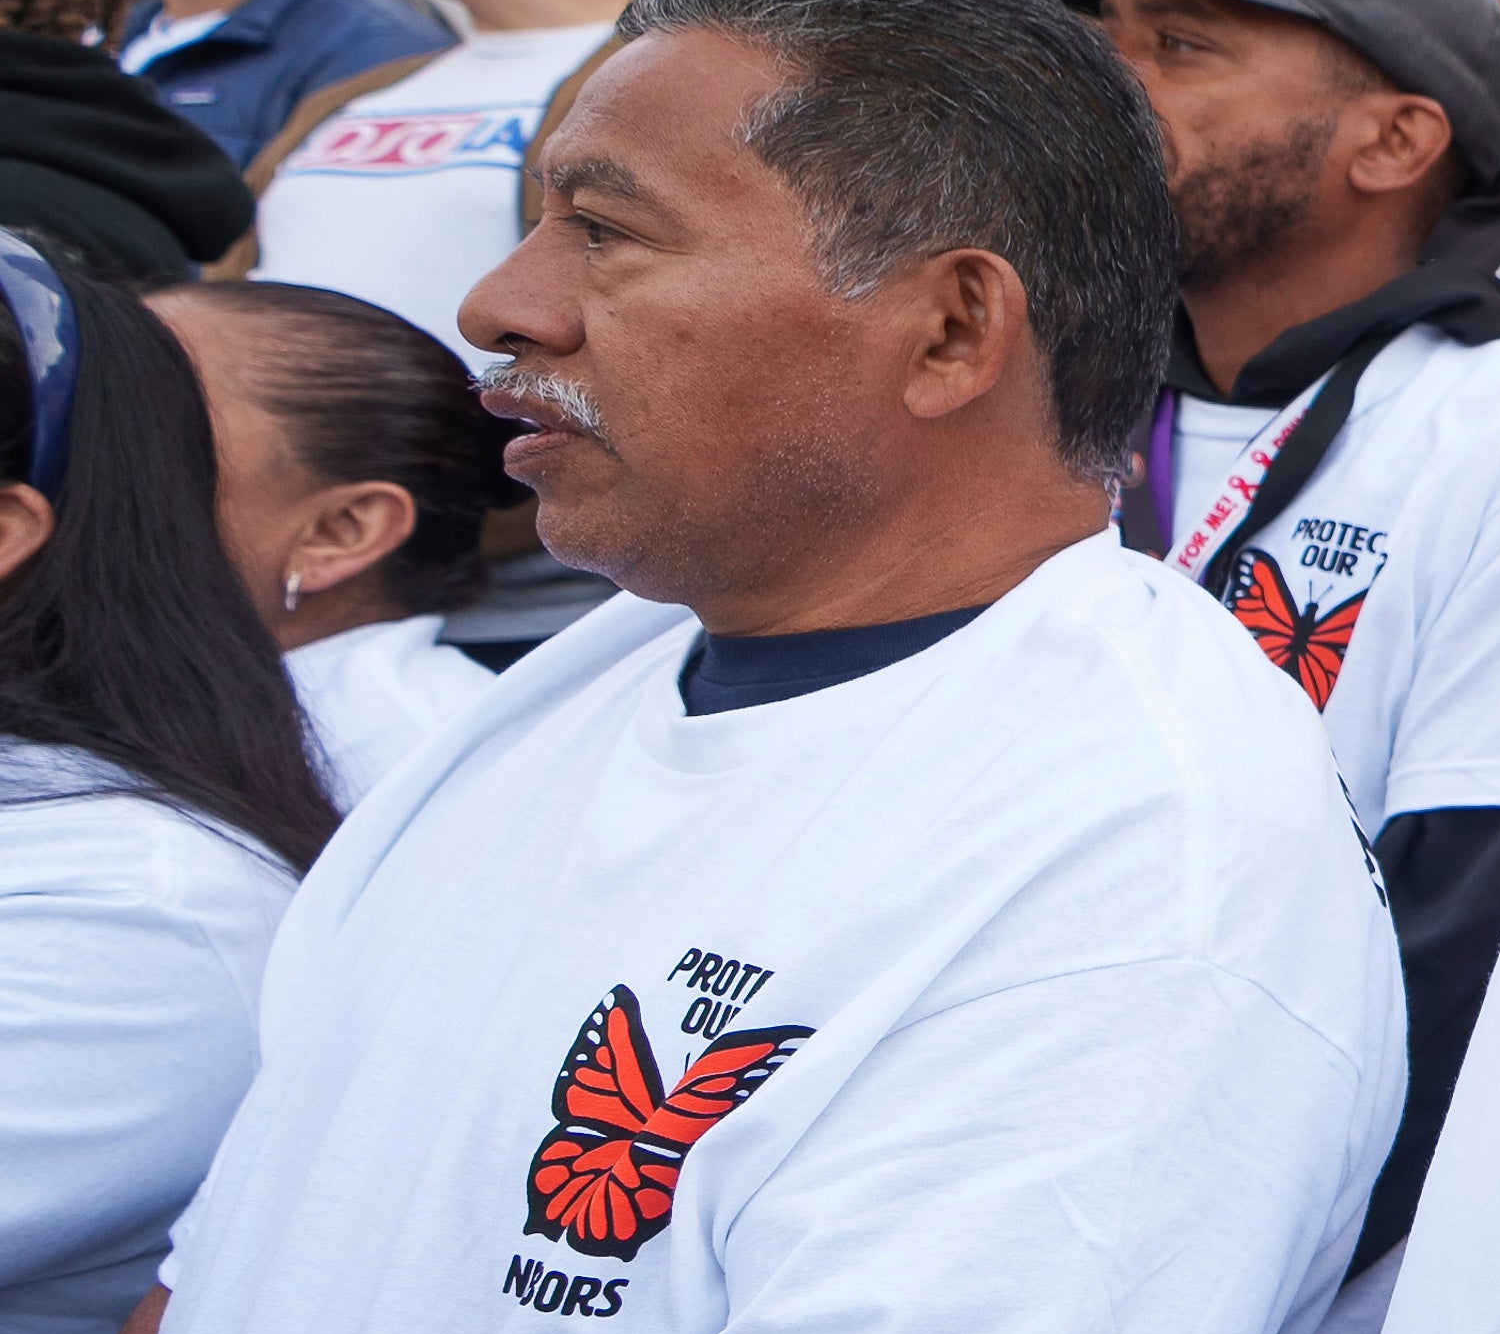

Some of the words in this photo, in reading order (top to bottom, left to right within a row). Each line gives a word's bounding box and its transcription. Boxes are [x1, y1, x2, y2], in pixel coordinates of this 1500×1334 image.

[1177, 530, 1210, 569] FOR
[1204, 495, 1239, 532] ME!
[1300, 544, 1359, 578] OUR
